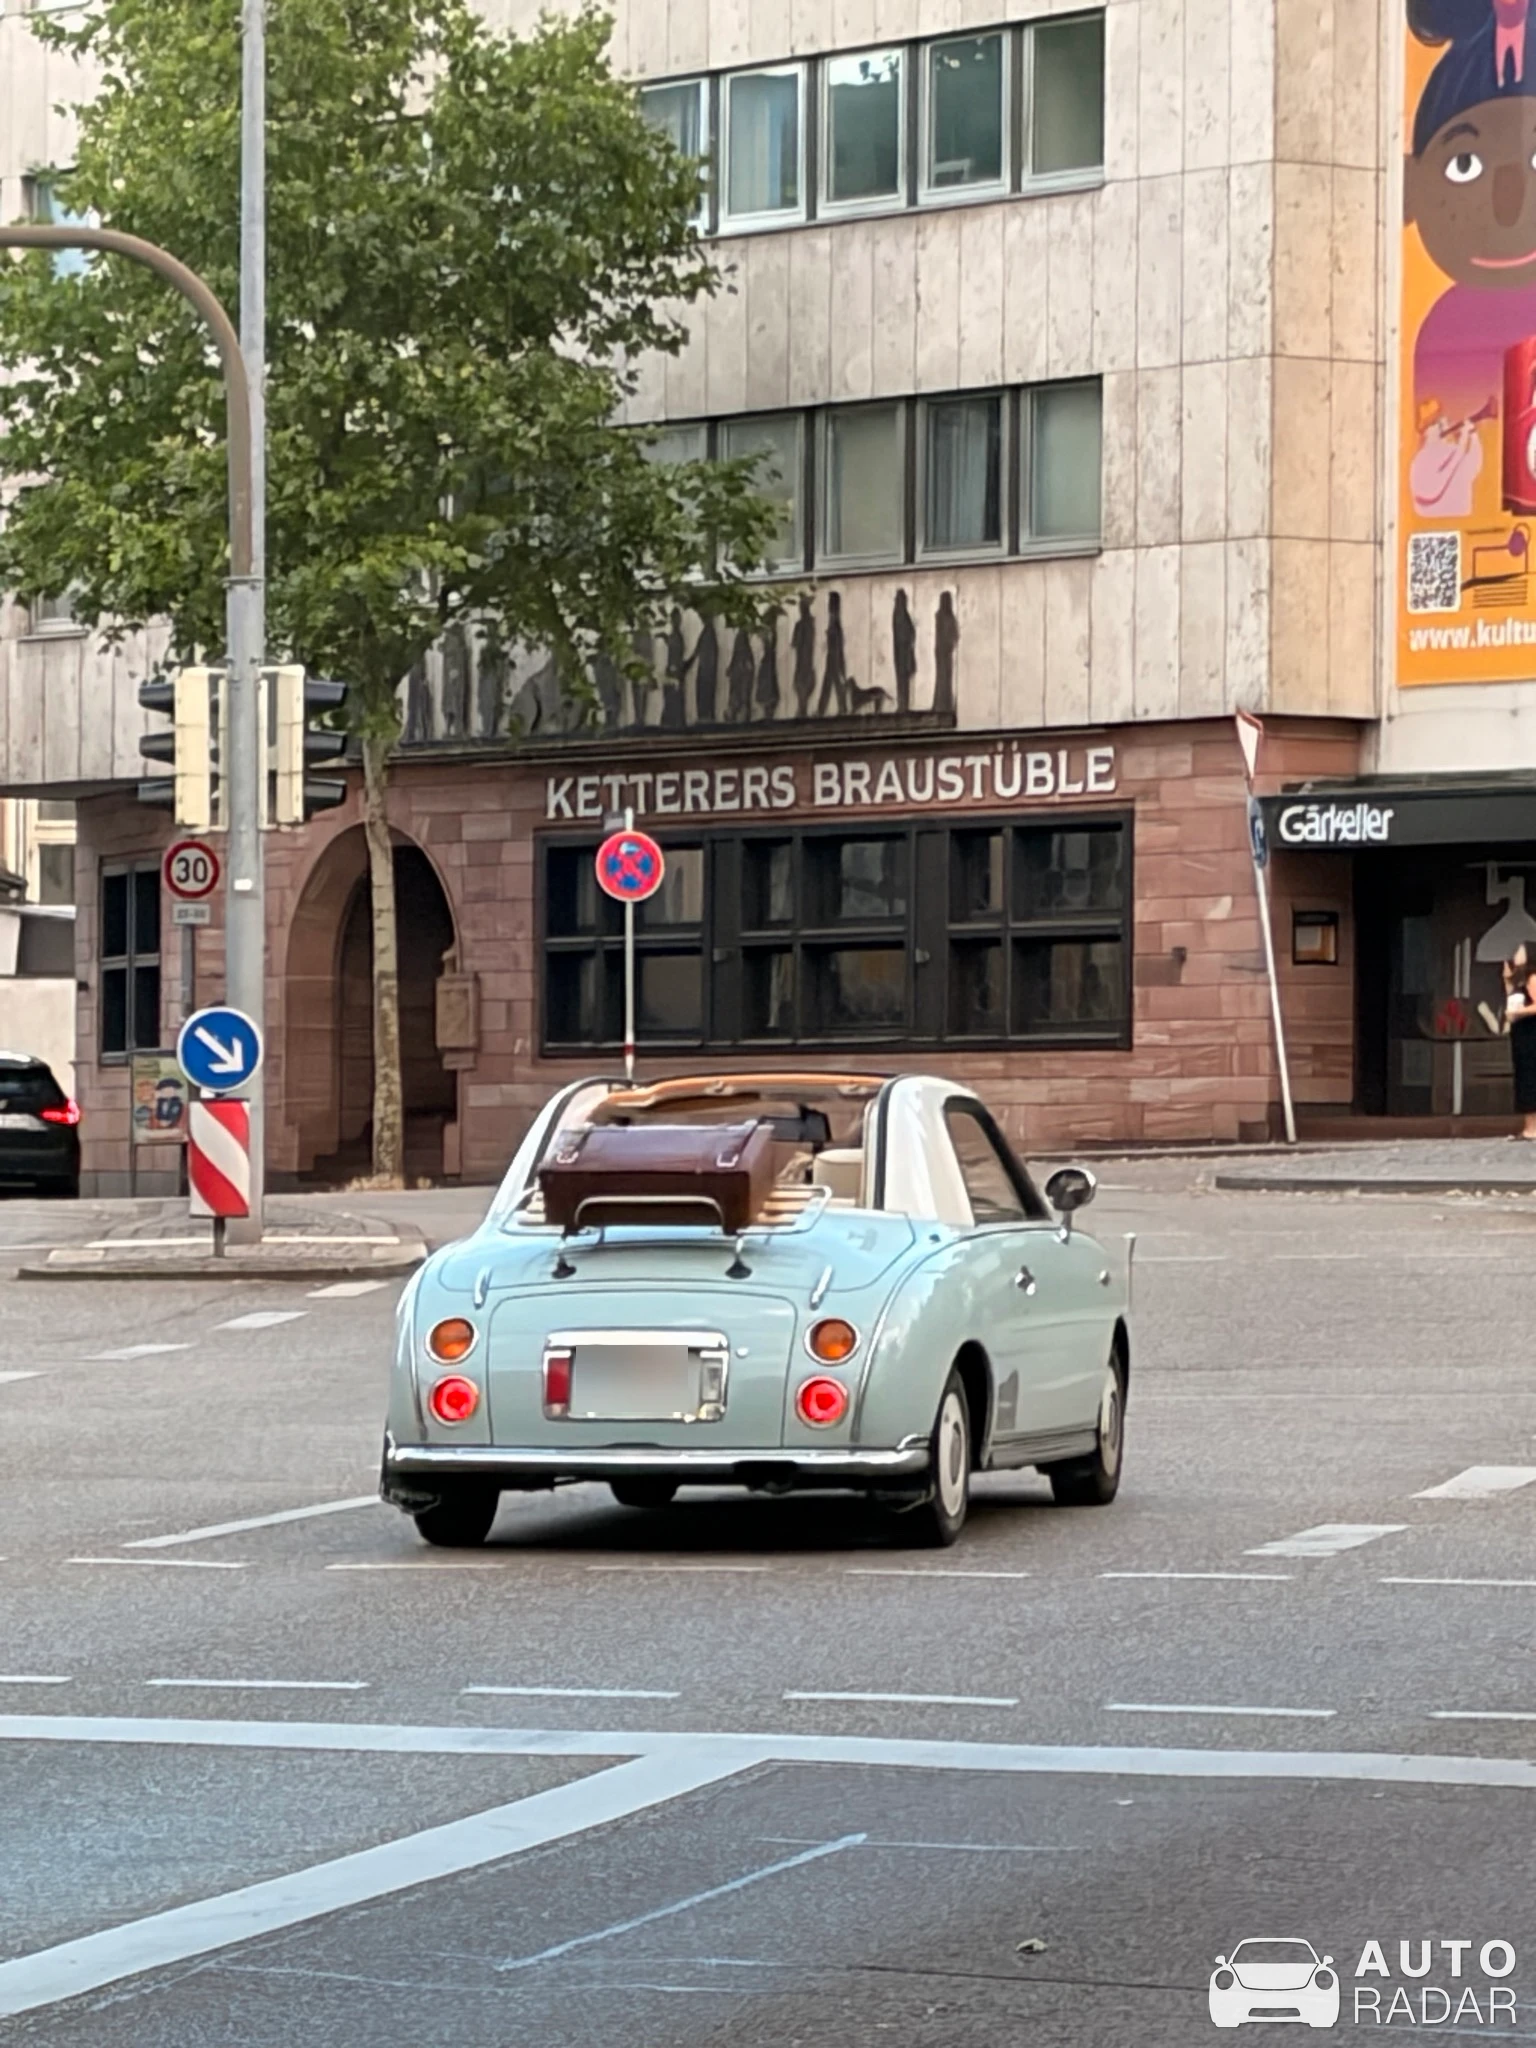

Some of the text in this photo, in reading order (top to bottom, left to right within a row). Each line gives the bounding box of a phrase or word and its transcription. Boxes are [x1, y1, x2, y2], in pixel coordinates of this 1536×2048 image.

[1409, 616, 1536, 652] www.kultu
[546, 741, 1116, 820] KETTERERS BRAUSTÜBLE
[176, 856, 208, 884] 30
